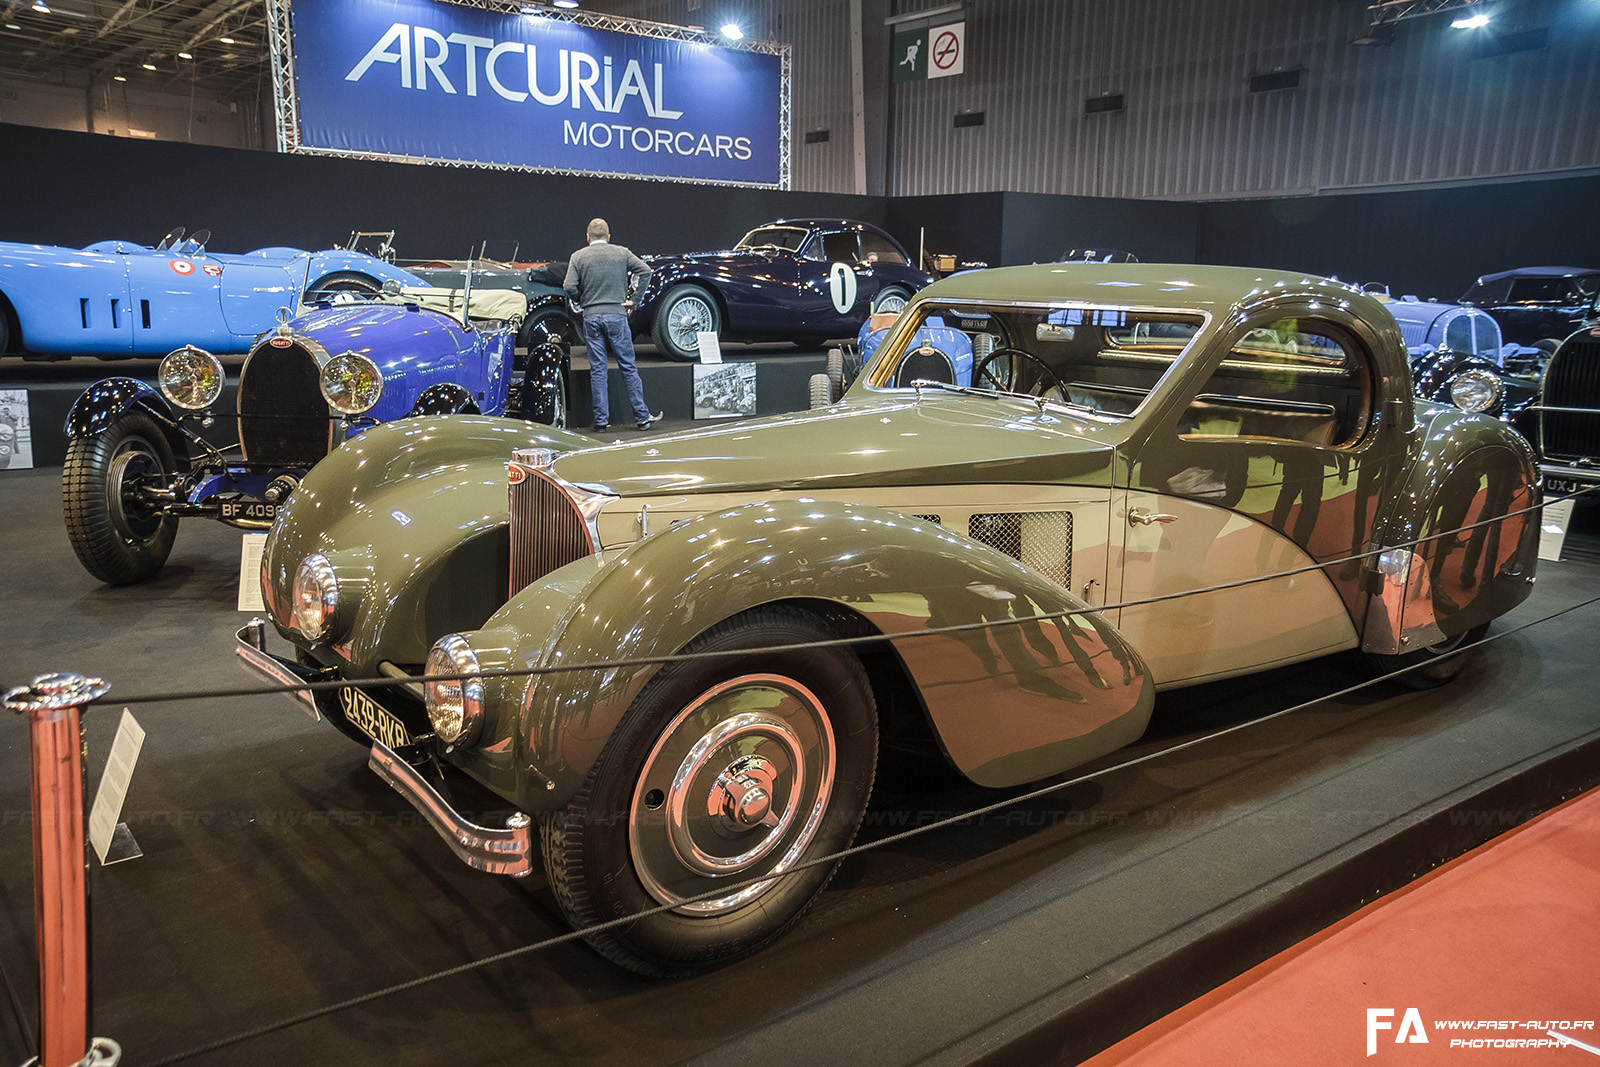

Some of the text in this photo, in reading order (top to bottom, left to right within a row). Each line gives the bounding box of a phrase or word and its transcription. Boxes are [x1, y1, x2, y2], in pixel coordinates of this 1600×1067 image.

[562, 120, 753, 161] MOTORCARS
[838, 268, 847, 306] 1
[1548, 479, 1577, 492] UXJ
[222, 503, 242, 517] BF
